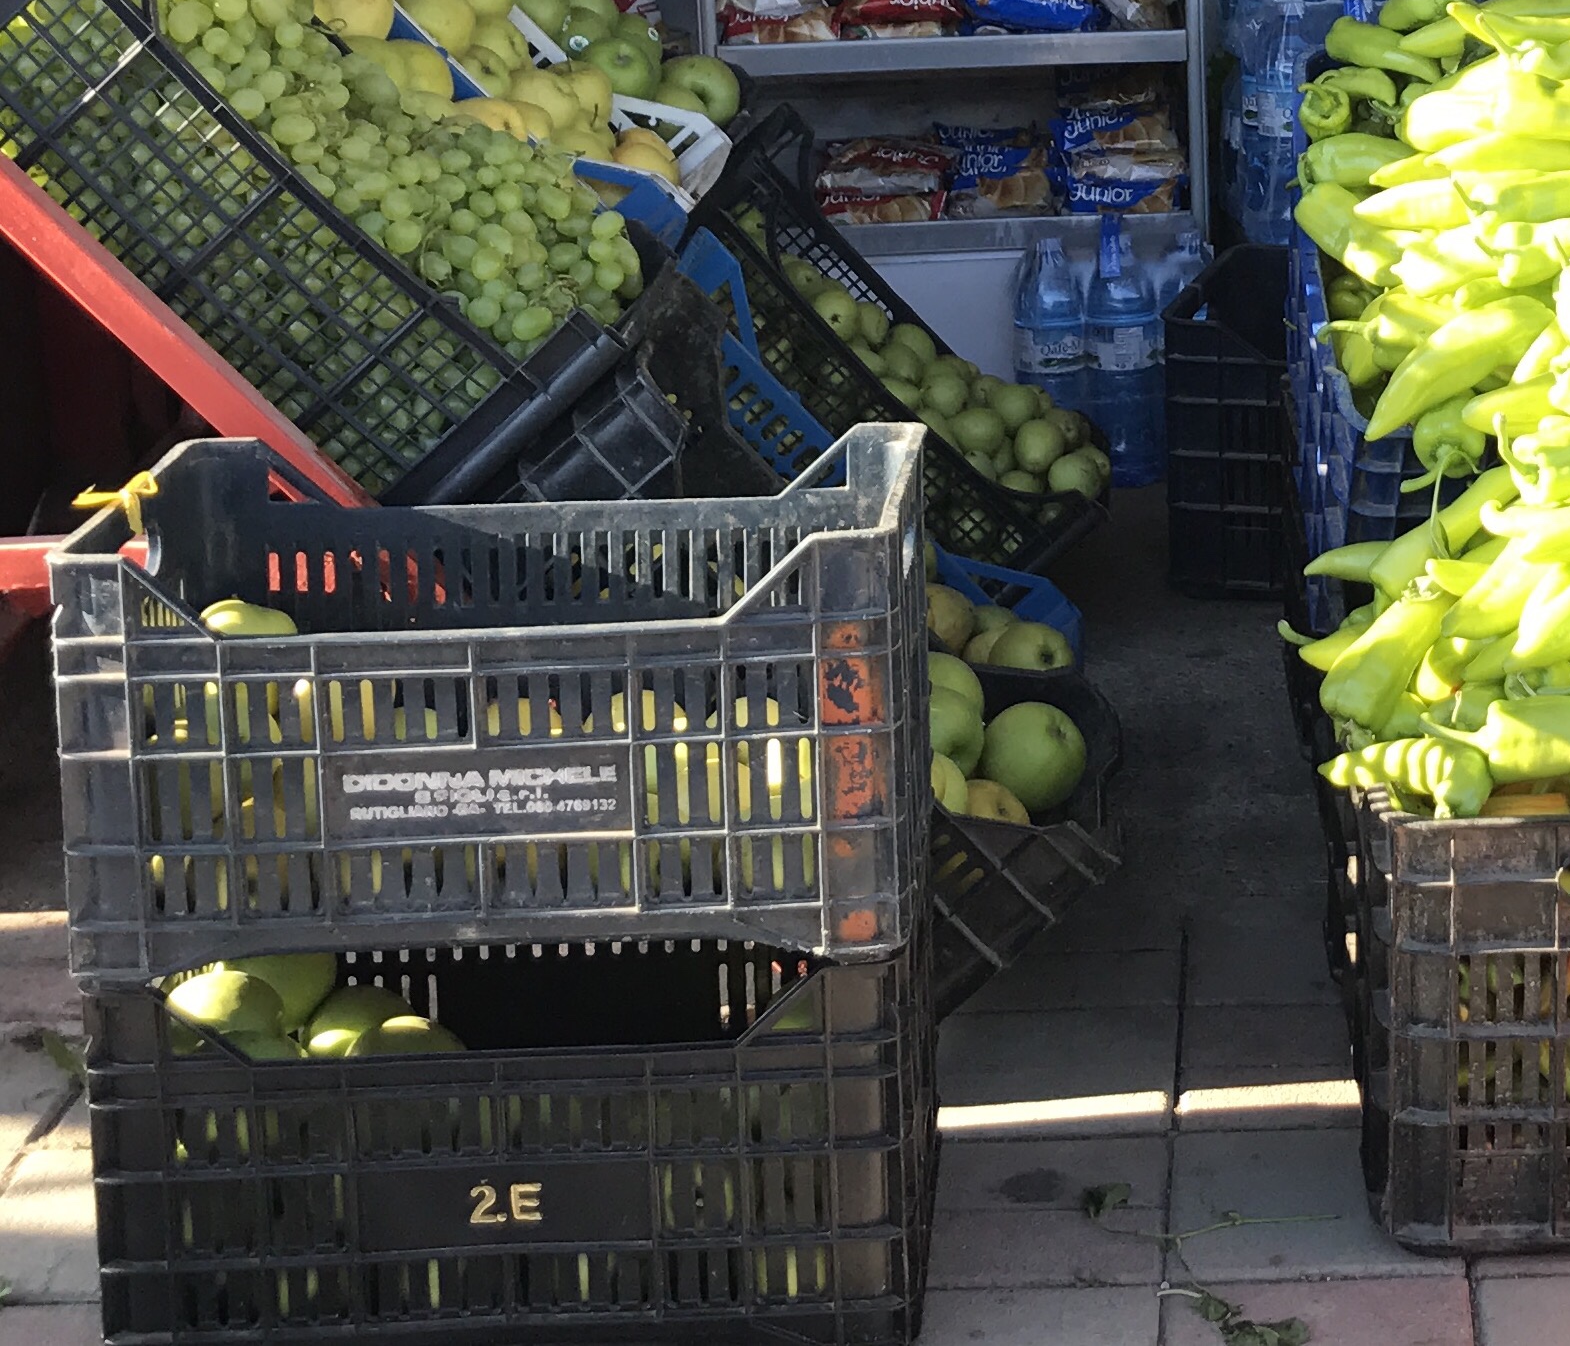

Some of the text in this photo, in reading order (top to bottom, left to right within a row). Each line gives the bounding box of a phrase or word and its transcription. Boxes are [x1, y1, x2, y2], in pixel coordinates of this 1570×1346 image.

[1069, 183, 1135, 204] Junior
[488, 764, 618, 788] MICHELE
[349, 805, 449, 821] RUTIGLIANO
[470, 1183, 543, 1224] 2.E
